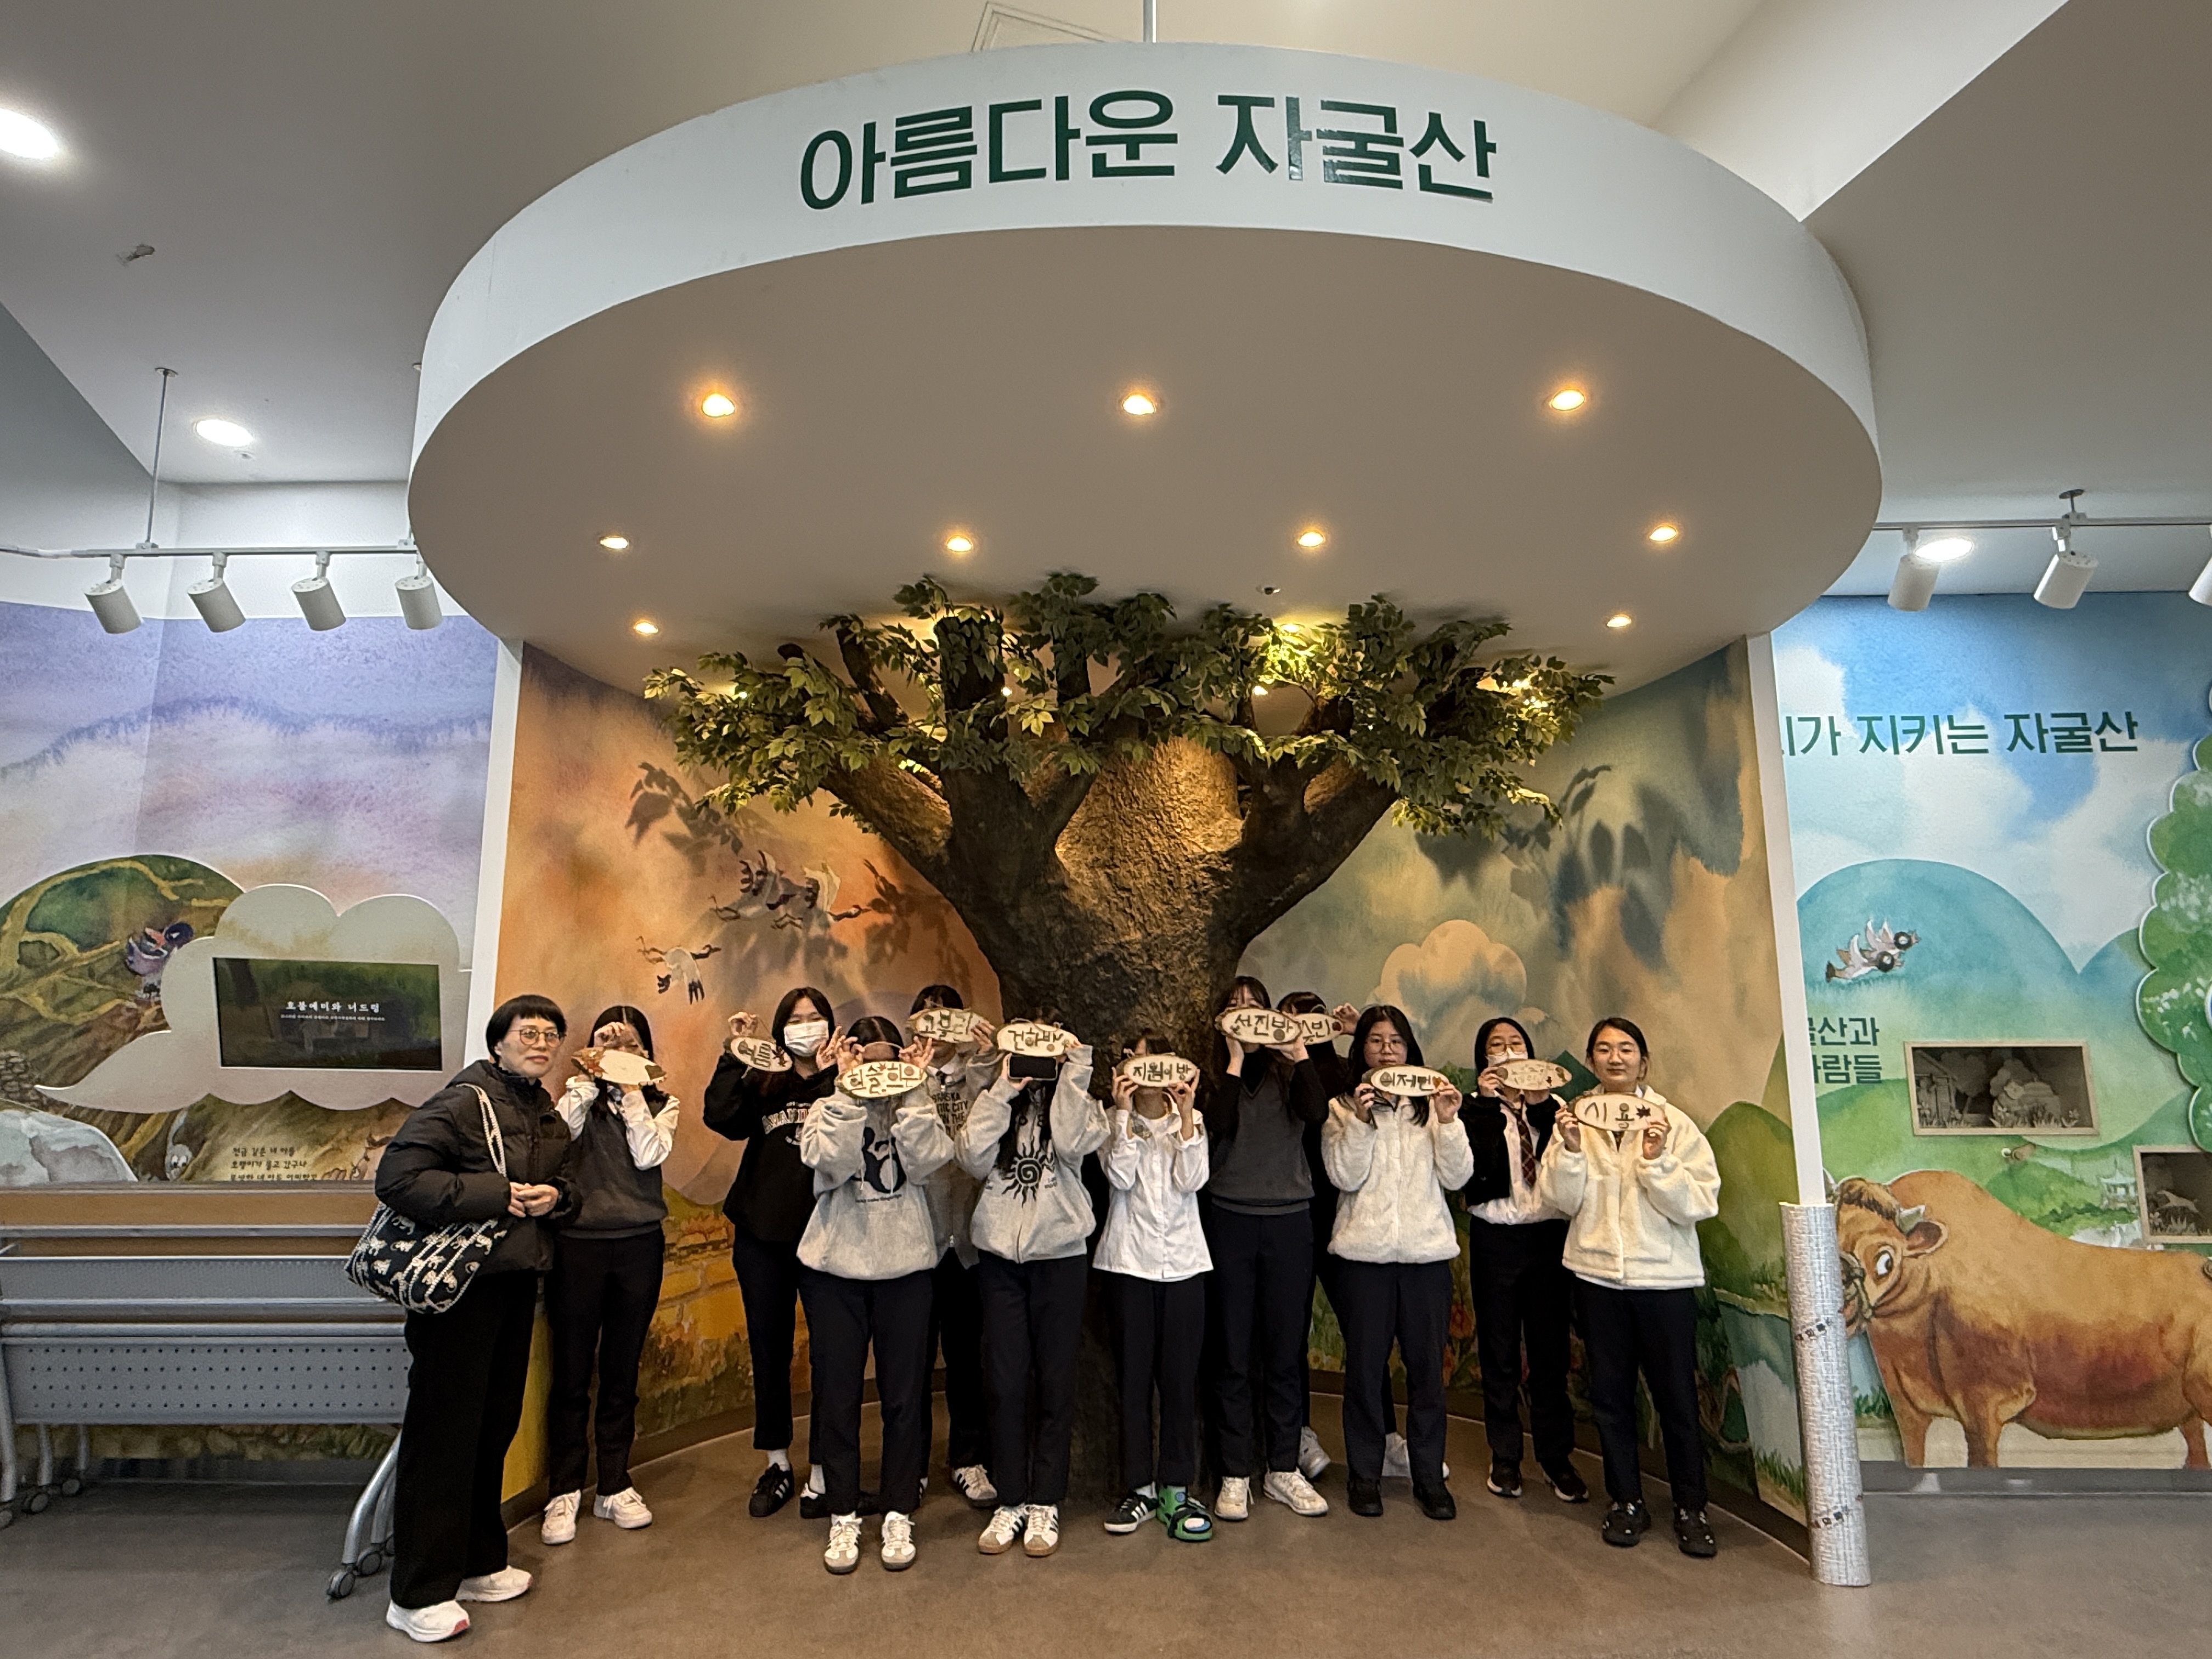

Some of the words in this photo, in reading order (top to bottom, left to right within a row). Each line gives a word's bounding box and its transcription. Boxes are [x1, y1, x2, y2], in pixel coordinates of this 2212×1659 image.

[800, 91, 1177, 210] 아름다운
[1215, 95, 1497, 202] 자굴산
[1857, 714, 1989, 755] 지키는
[2004, 711, 2138, 753] 자굴산
[952, 1100, 968, 1113] CITY
